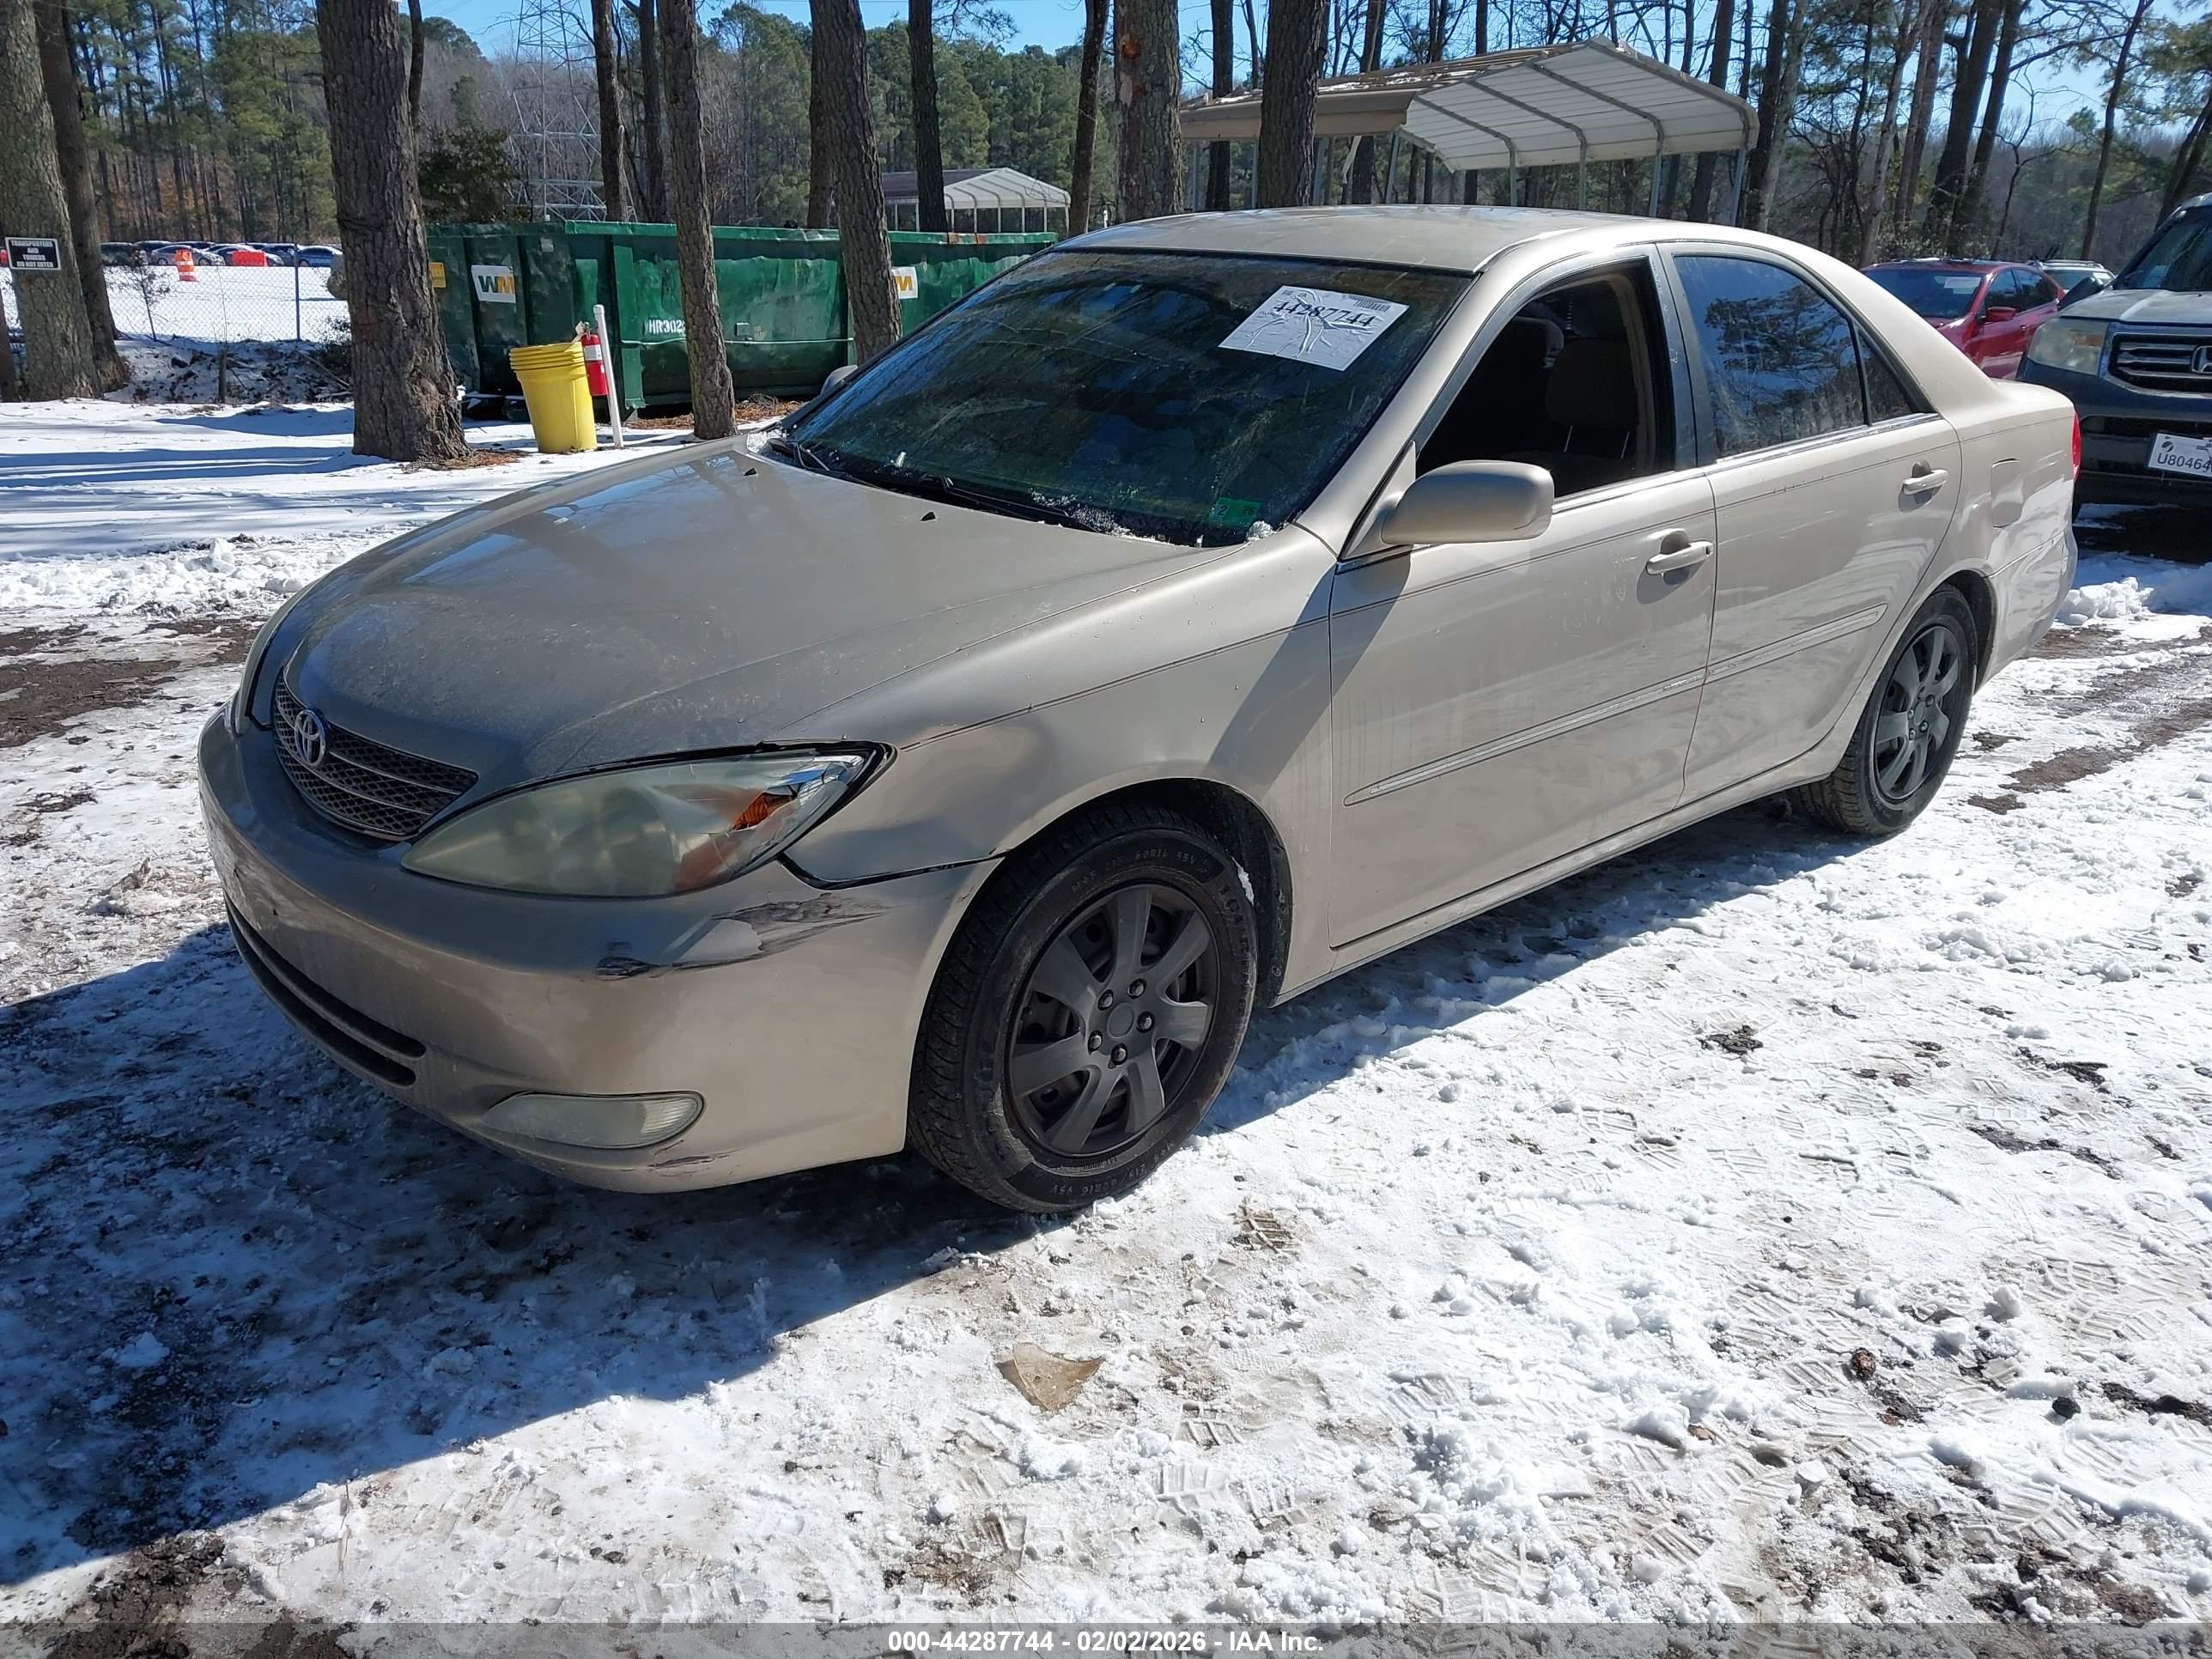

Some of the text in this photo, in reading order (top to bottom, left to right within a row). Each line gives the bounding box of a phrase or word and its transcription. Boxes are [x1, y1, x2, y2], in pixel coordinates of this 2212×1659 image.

[477, 275, 514, 294] WM
[1273, 301, 1376, 327] 44287744
[2157, 453, 2212, 472] U80464
